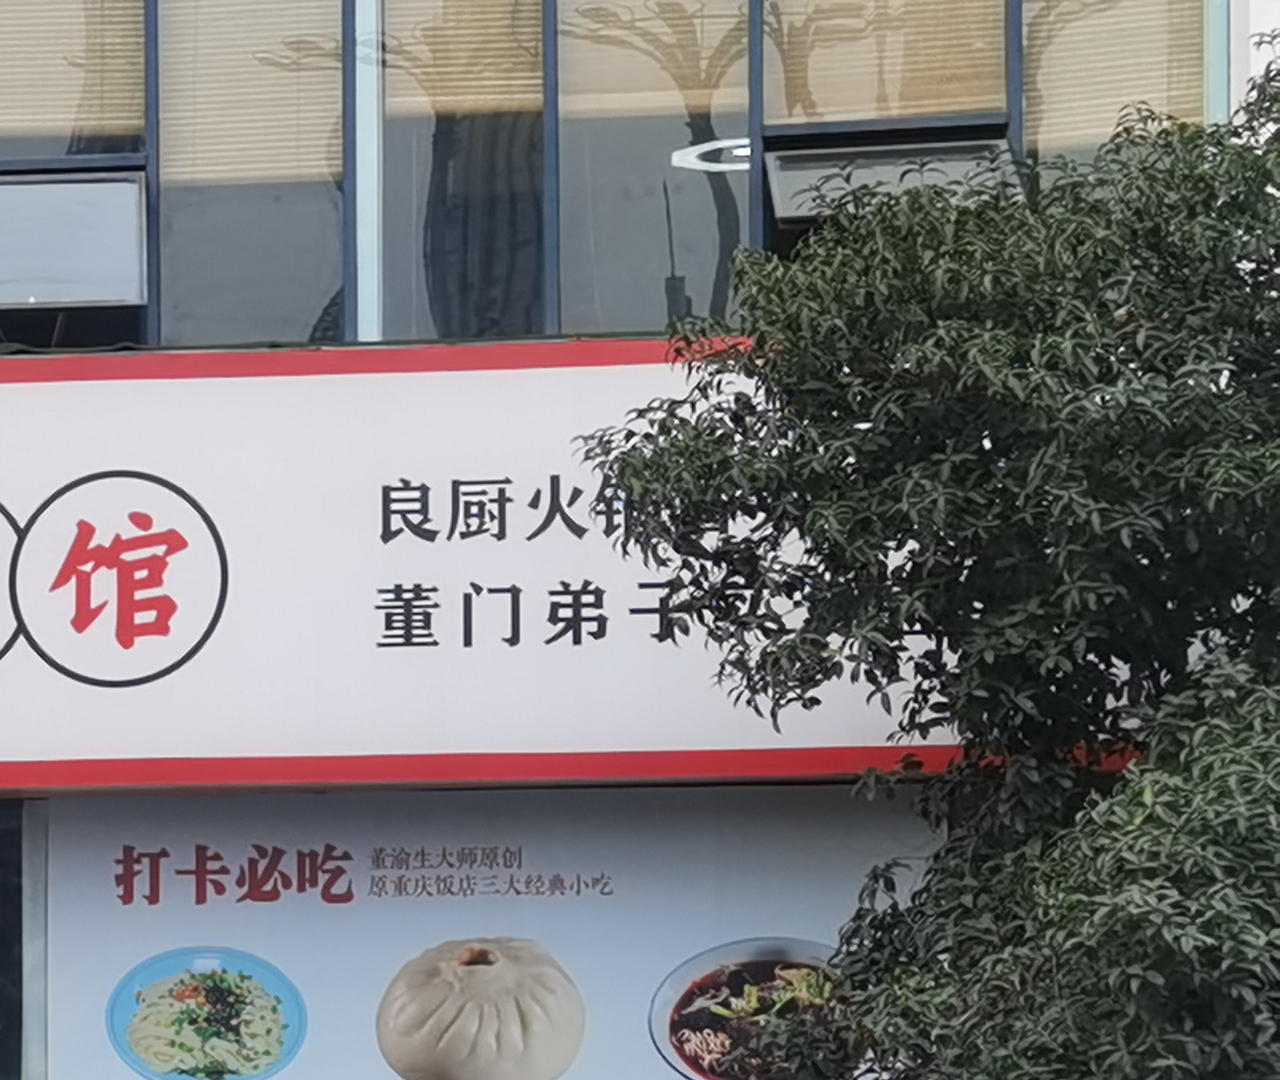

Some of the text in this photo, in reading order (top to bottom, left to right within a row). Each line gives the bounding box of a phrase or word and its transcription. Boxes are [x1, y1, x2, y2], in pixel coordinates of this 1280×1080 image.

[113, 843, 355, 905] 打卡必吃
[367, 873, 614, 899] 原重庆饭店三大经典小吃
